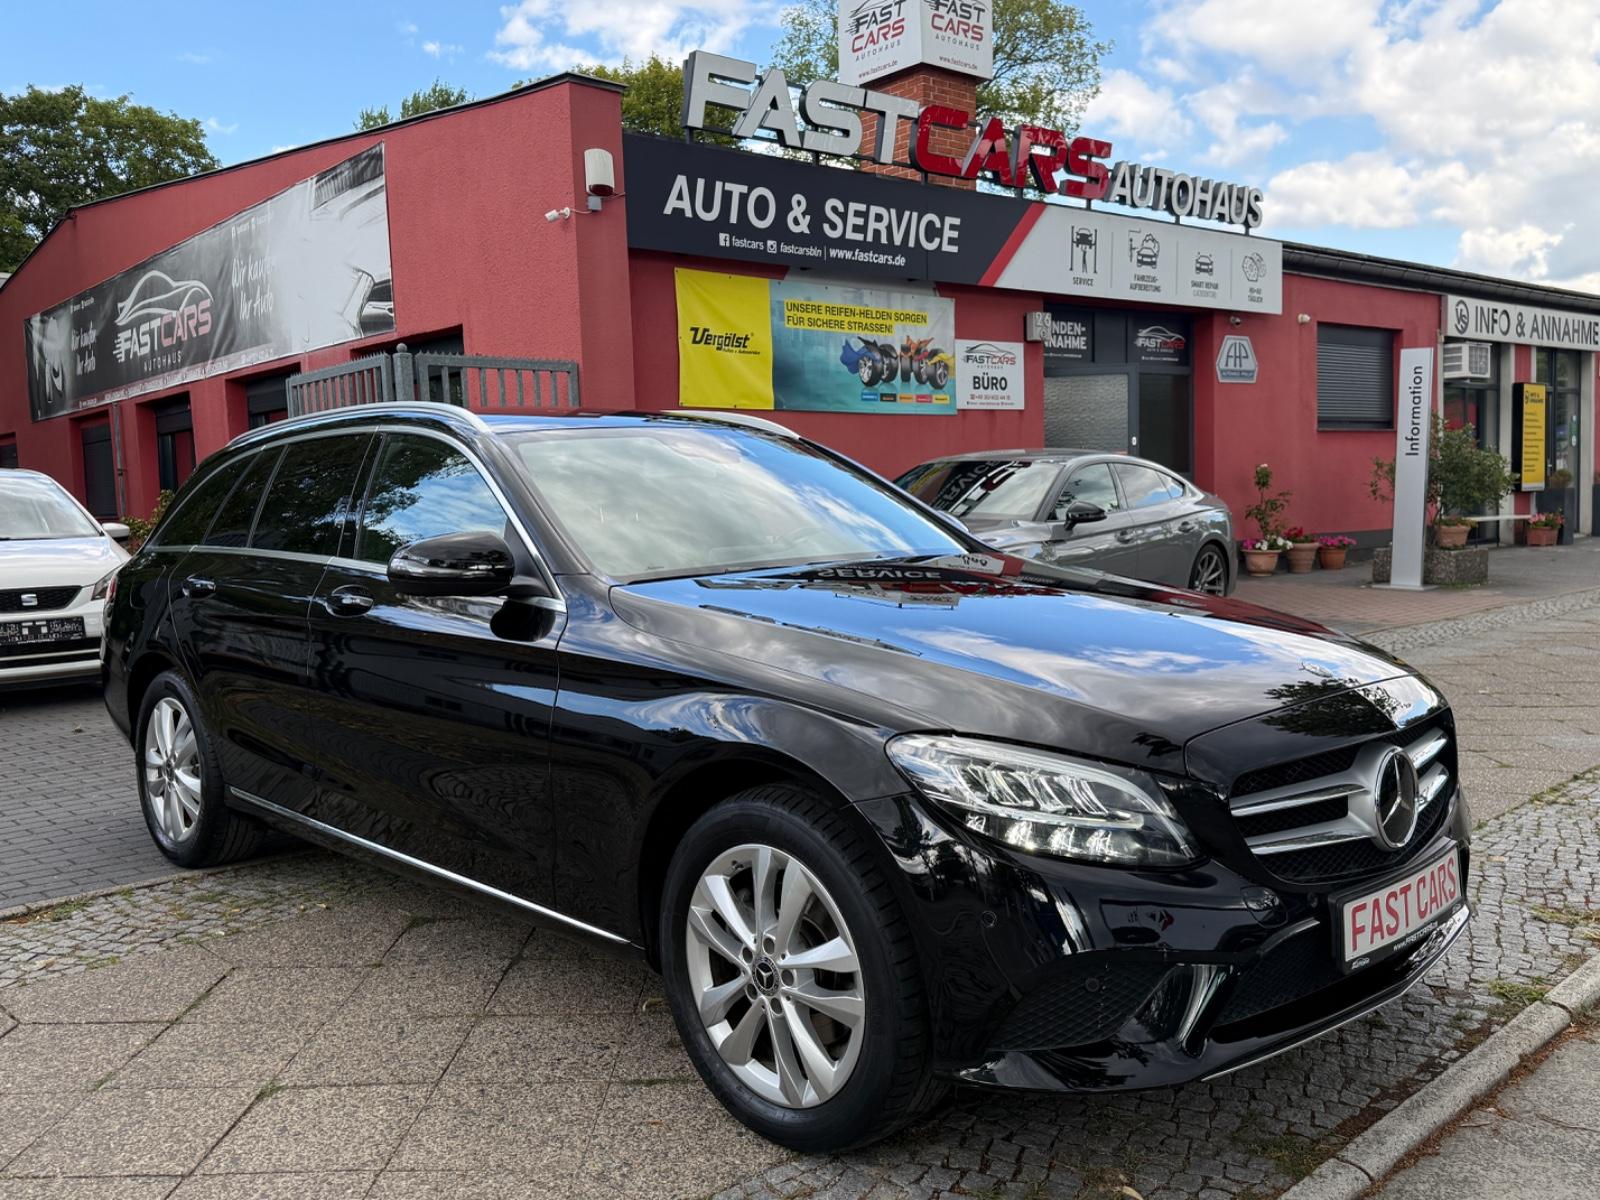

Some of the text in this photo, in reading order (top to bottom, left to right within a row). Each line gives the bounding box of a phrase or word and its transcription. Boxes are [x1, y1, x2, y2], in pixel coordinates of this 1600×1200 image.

[851, 0, 906, 34] FAST
[933, 0, 986, 23] FAST
[852, 18, 905, 53] CARS
[931, 13, 984, 42] CARS
[855, 41, 901, 62] AUTOHAUS
[935, 33, 980, 51] AUTOHAUS
[858, 59, 899, 79] www.fastcars.de
[938, 54, 978, 71] www.fastcars.de
[1109, 161, 1264, 229] AUTOHAUS
[662, 174, 962, 253] AUTO & SERVICE
[732, 235, 765, 251] fastcars
[829, 247, 907, 267] www.fastcars.de
[1072, 276, 1094, 287] SERVICE
[785, 301, 928, 324] UNSERE REIFEN-HELDEN SORGEN
[786, 314, 893, 334] FÜR SICHERE STRASSEN!
[1475, 305, 1511, 336] INFO
[1515, 311, 1526, 338] &
[1529, 313, 1599, 345] ANNAHME
[689, 326, 751, 351] Vergölst
[143, 350, 183, 372] AUTOHAUS
[972, 371, 1008, 391] BÜRO
[1405, 366, 1423, 456] Information
[1350, 883, 1412, 952] FAST
[1416, 856, 1457, 920] CARS
